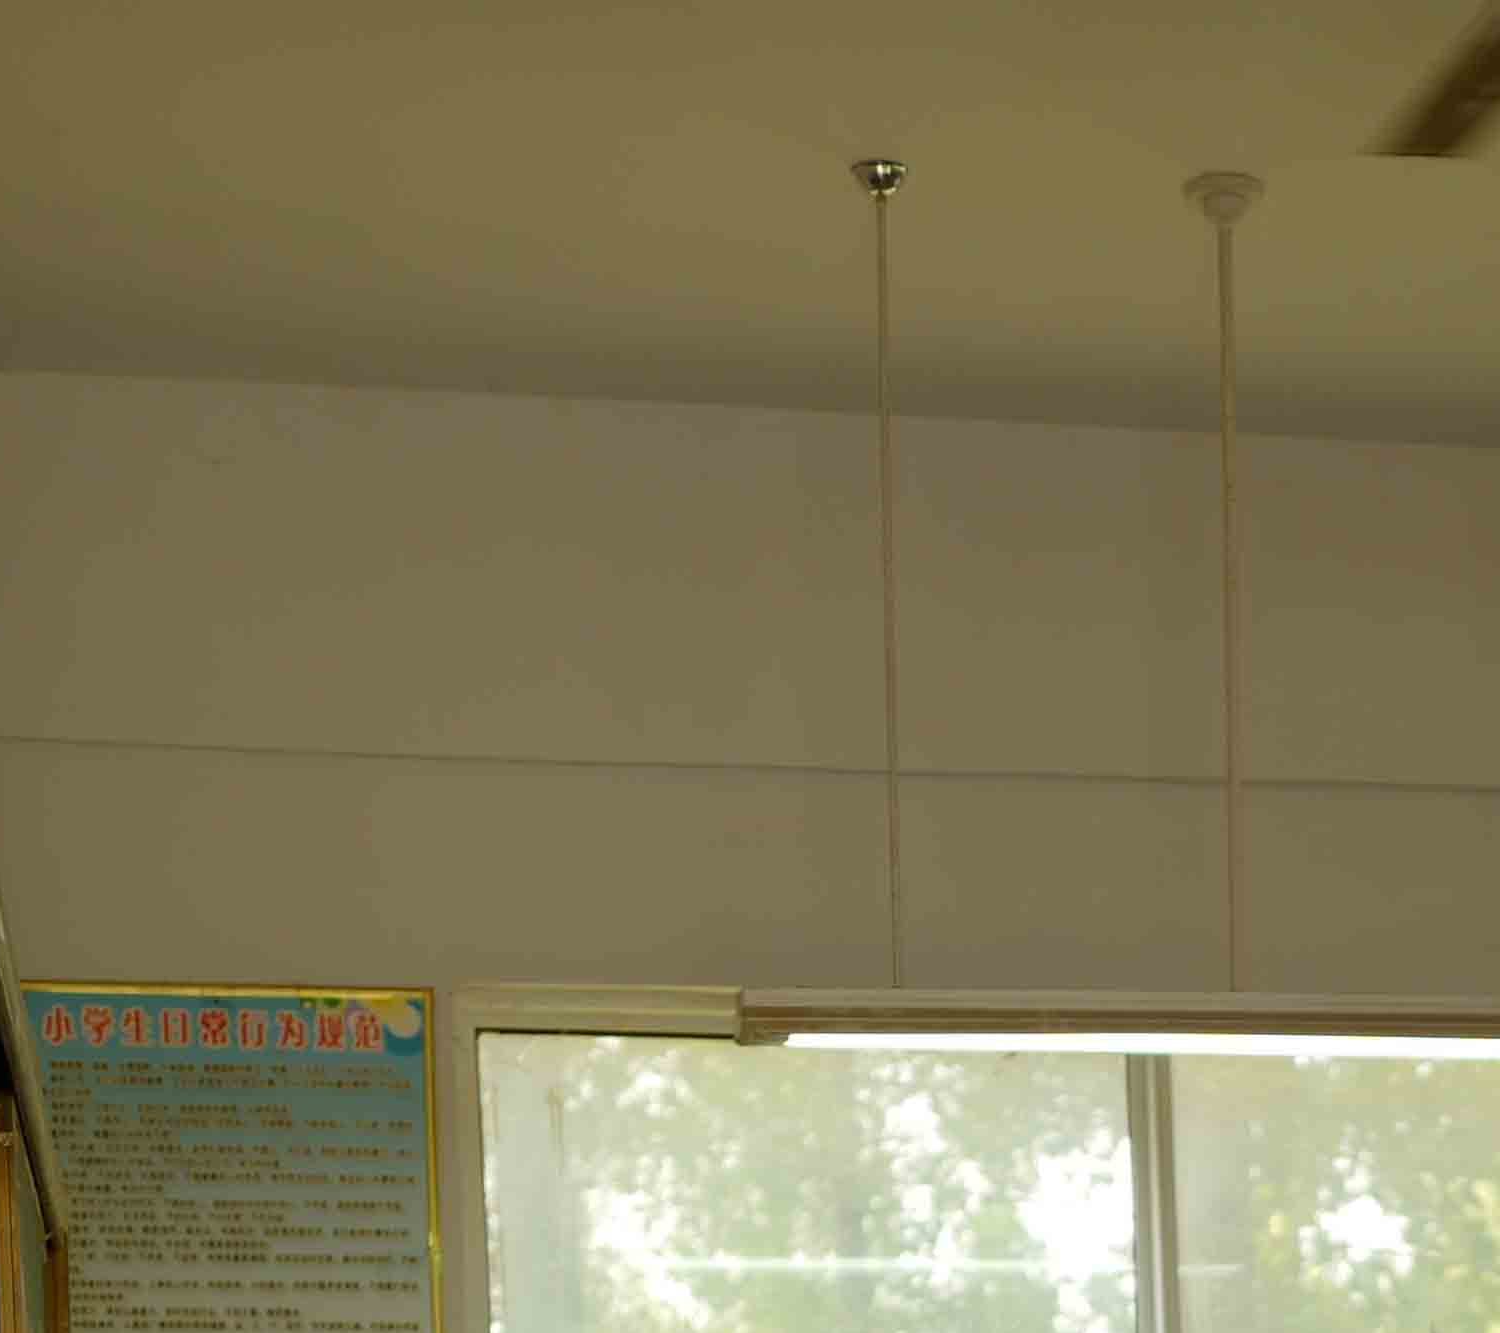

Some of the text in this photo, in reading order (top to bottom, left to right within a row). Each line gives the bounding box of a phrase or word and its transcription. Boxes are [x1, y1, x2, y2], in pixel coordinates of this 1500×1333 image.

[43, 1004, 385, 1051] 小学生日常行为规范
